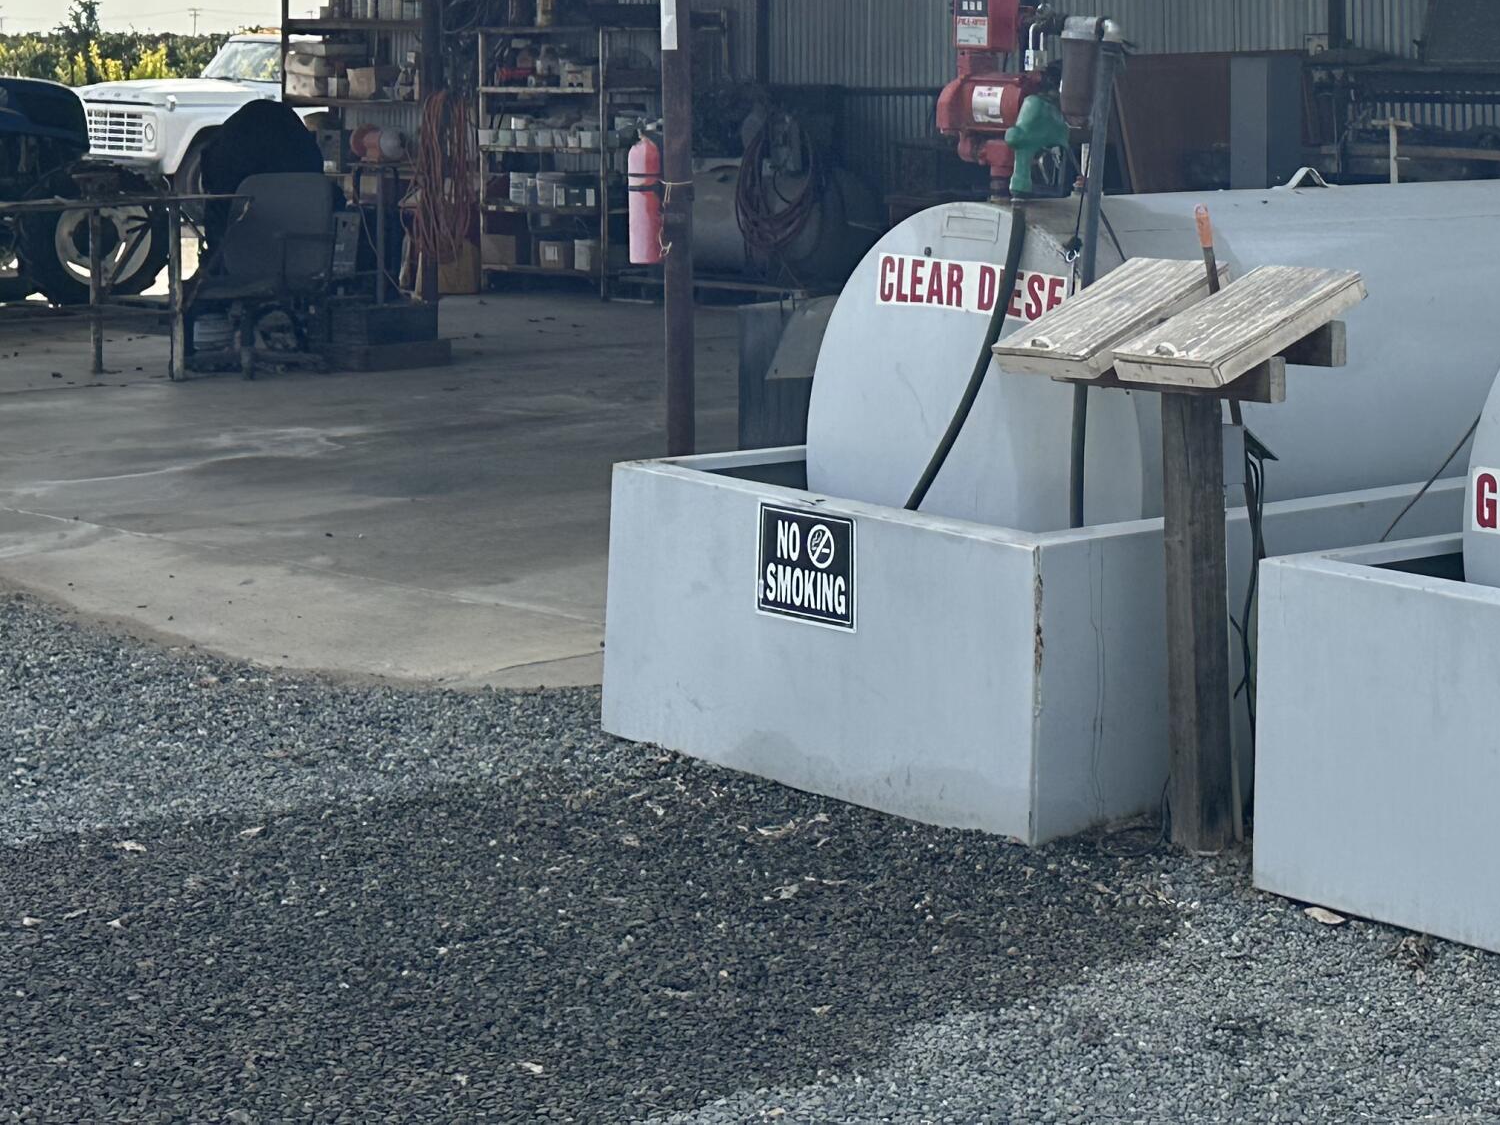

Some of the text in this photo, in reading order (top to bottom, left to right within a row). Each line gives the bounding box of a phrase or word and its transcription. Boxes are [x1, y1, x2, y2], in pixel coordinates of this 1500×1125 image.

[879, 255, 1065, 322] CLEAR DESE
[776, 519, 801, 562] NO
[765, 562, 846, 615] SMOKING
